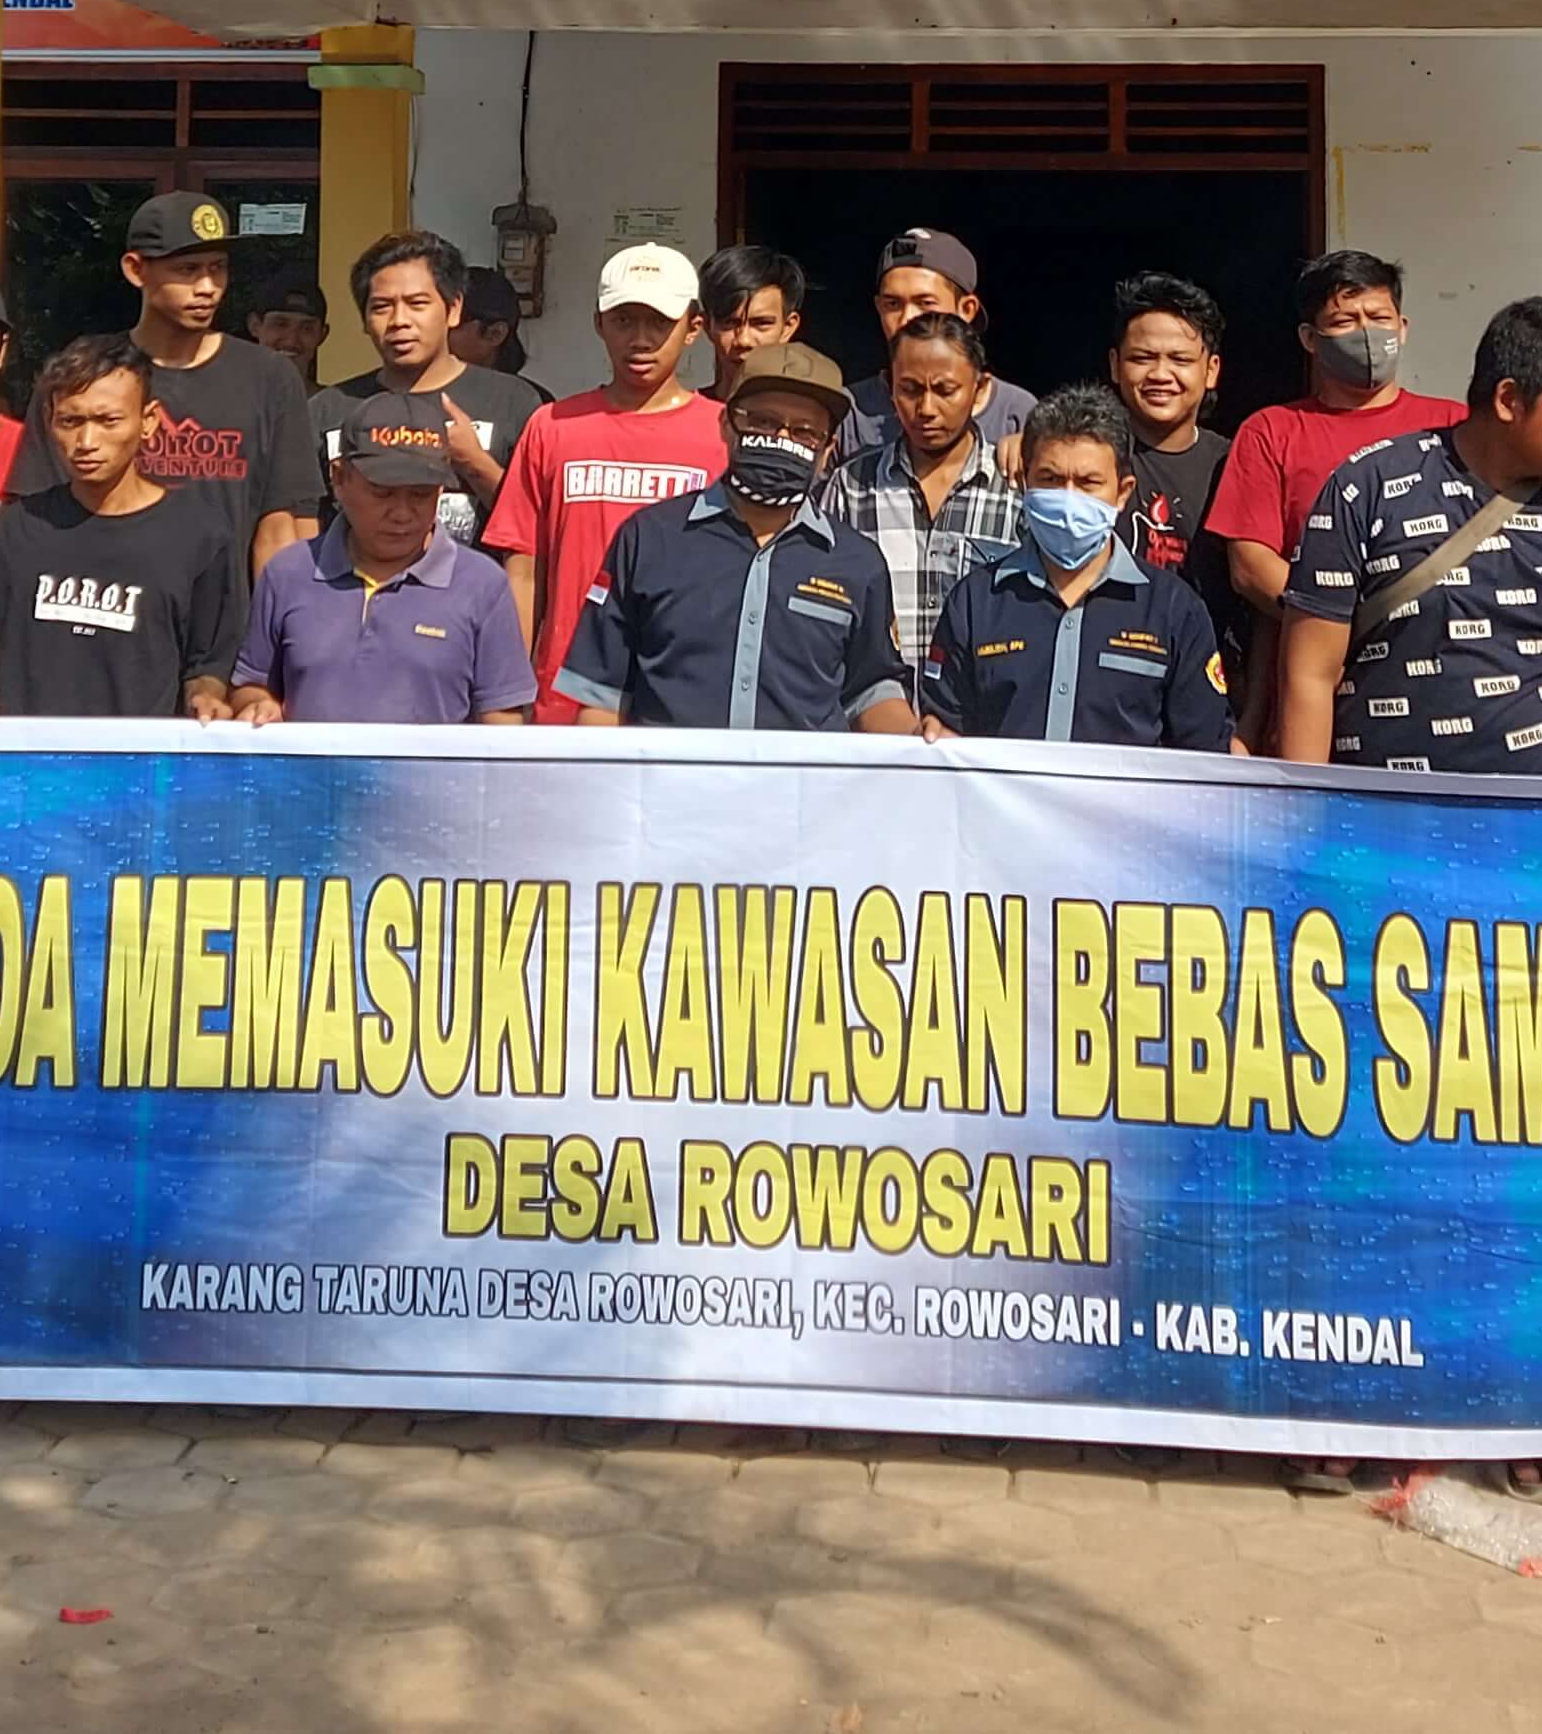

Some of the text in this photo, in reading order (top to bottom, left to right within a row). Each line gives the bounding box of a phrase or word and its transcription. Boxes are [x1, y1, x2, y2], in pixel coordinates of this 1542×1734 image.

[1409, 519, 1443, 534] KORG
[1315, 570, 1354, 586] KORG
[1495, 588, 1537, 605] KORG
[1454, 623, 1486, 635] KORG
[1480, 680, 1516, 694] KORG
[1373, 701, 1405, 714] KORG
[1431, 717, 1474, 736] KORG
[1512, 729, 1542, 747] KORG
[101, 874, 571, 1098] MEMASUKI
[591, 879, 1027, 1118] KAWASAN
[1052, 897, 1349, 1142] BEBAS
[443, 1132, 1110, 1266] DESA ROWOSARI
[141, 1262, 305, 1315] KARANG
[312, 1264, 468, 1318] TARUNA
[477, 1269, 581, 1322] DESA
[588, 1274, 804, 1339] ROWOSARI,
[813, 1283, 905, 1336] KEC.
[915, 1286, 1121, 1348] ROWOSARI
[1153, 1302, 1250, 1358] KAB.
[1262, 1309, 1424, 1367] KENDAL
